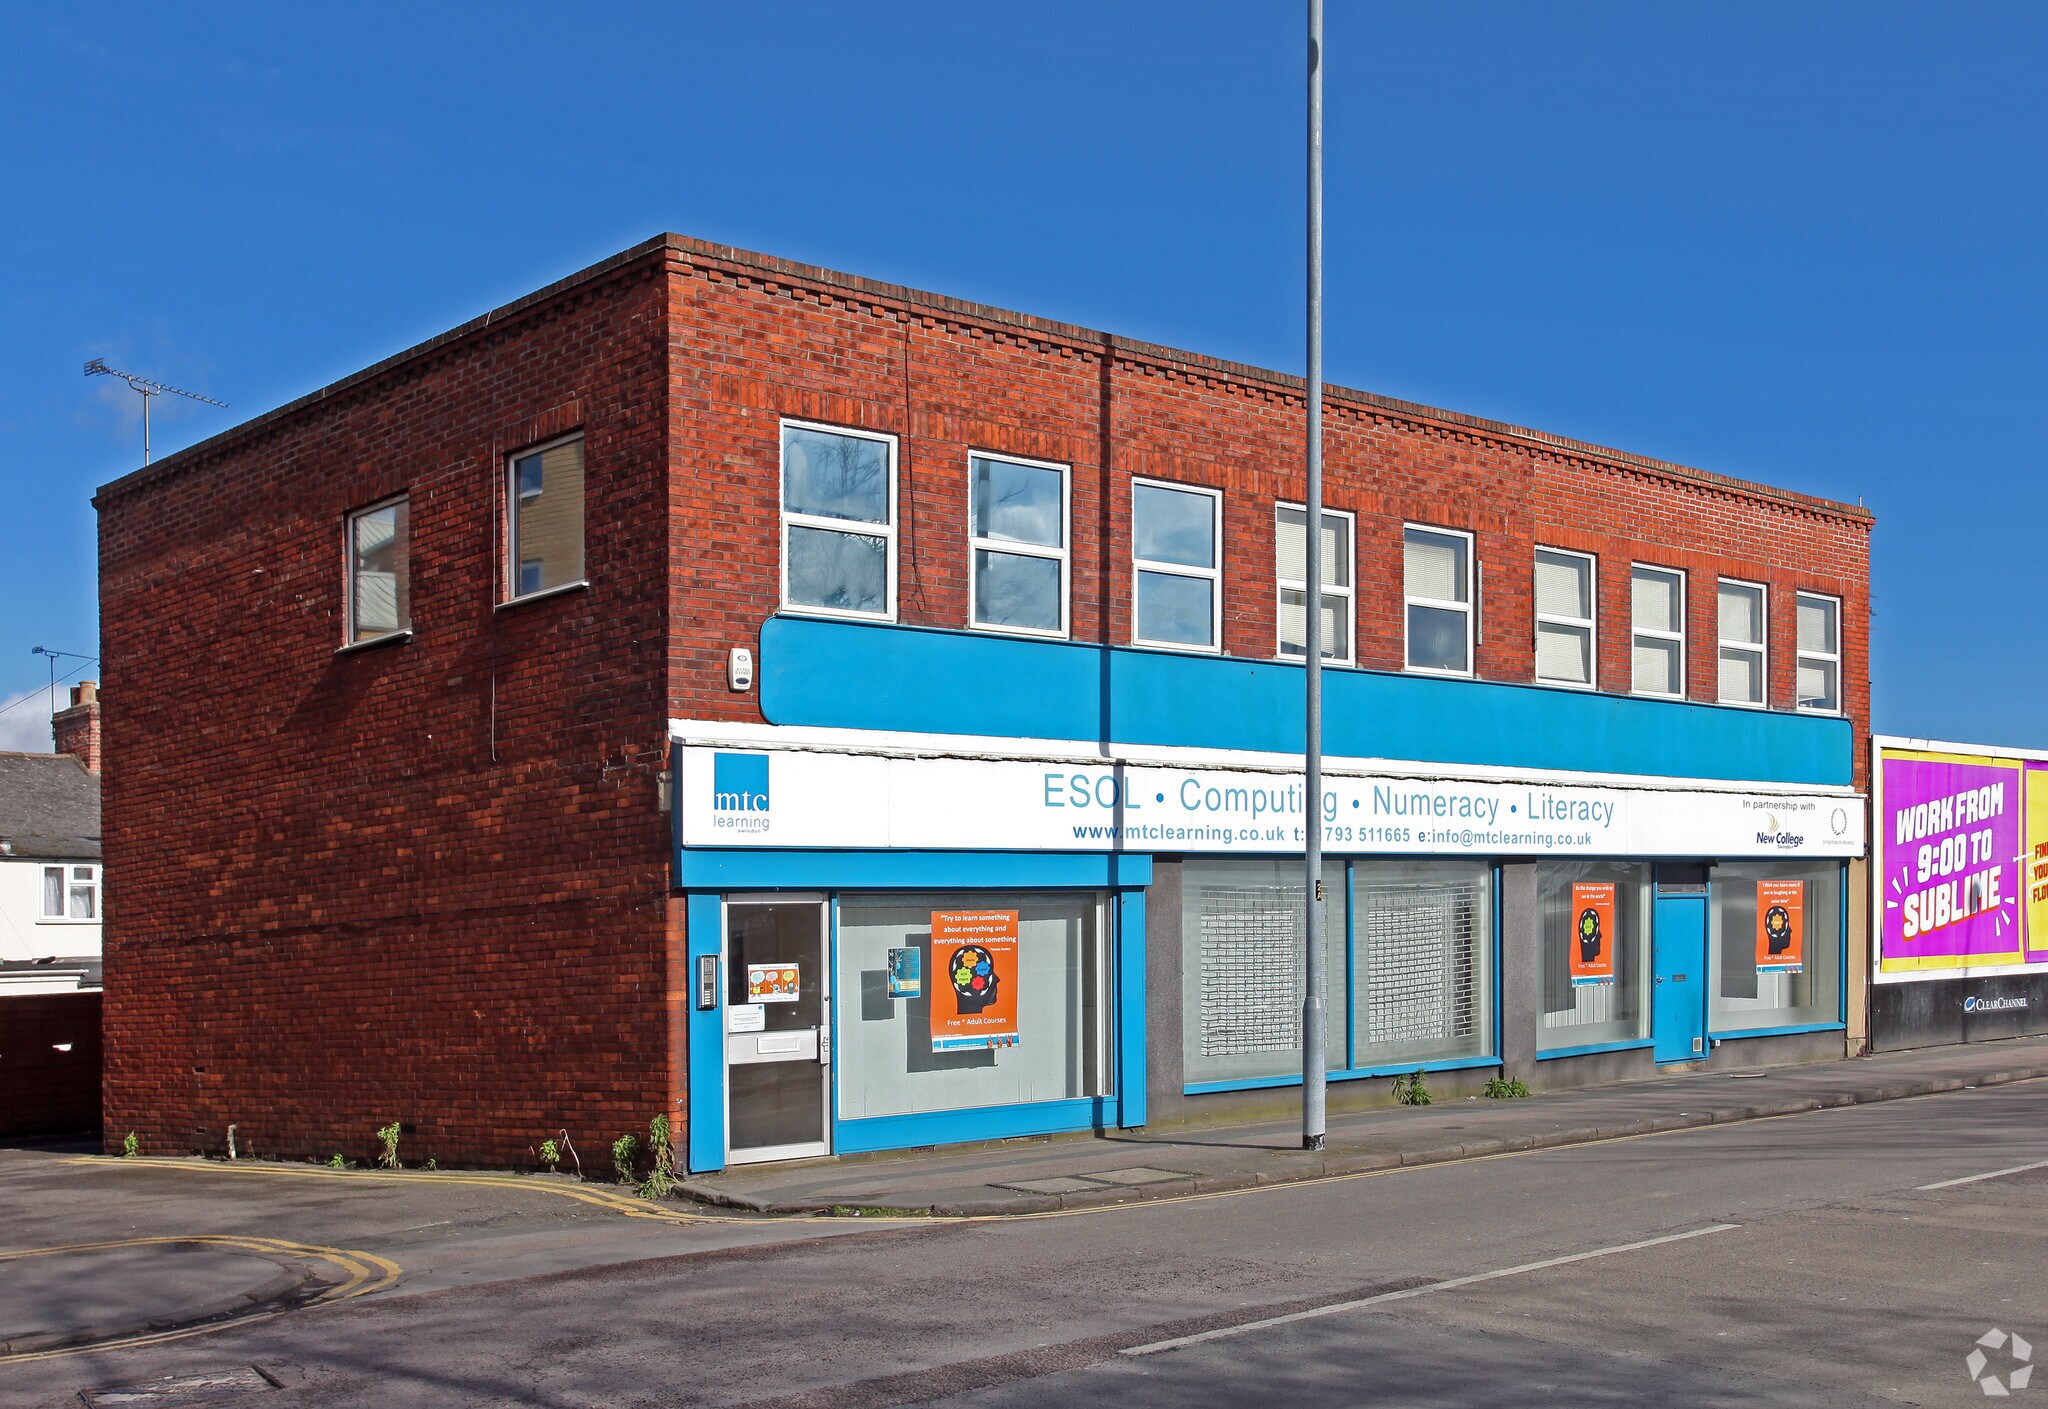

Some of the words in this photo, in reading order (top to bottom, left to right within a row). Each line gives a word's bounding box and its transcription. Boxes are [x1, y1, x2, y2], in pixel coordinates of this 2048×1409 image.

[715, 790, 768, 812] mtc
[1044, 774, 1141, 809] ESOL
[1180, 778, 1337, 822] Computig
[1374, 785, 1499, 825] Numeracy
[1528, 792, 1614, 828] Literacy
[1743, 799, 1751, 808] In
[1753, 800, 1798, 812] partnership
[1800, 802, 1816, 811] with
[713, 815, 770, 831] learning
[1896, 795, 1954, 846] WORK
[1955, 781, 2005, 828] FROM
[1073, 823, 1284, 845] www.mtclearning.co.uk
[1359, 828, 1410, 842] 511665
[1418, 829, 1592, 848] e:info@mtclearning.co.uk
[1756, 832, 1775, 844] New
[1776, 832, 1804, 847] College
[1916, 833, 1967, 883] 9:00
[1970, 828, 1993, 865] TO
[1902, 865, 2002, 940] SUBLIME
[979, 914, 1010, 922] something
[934, 937, 966, 945] everything
